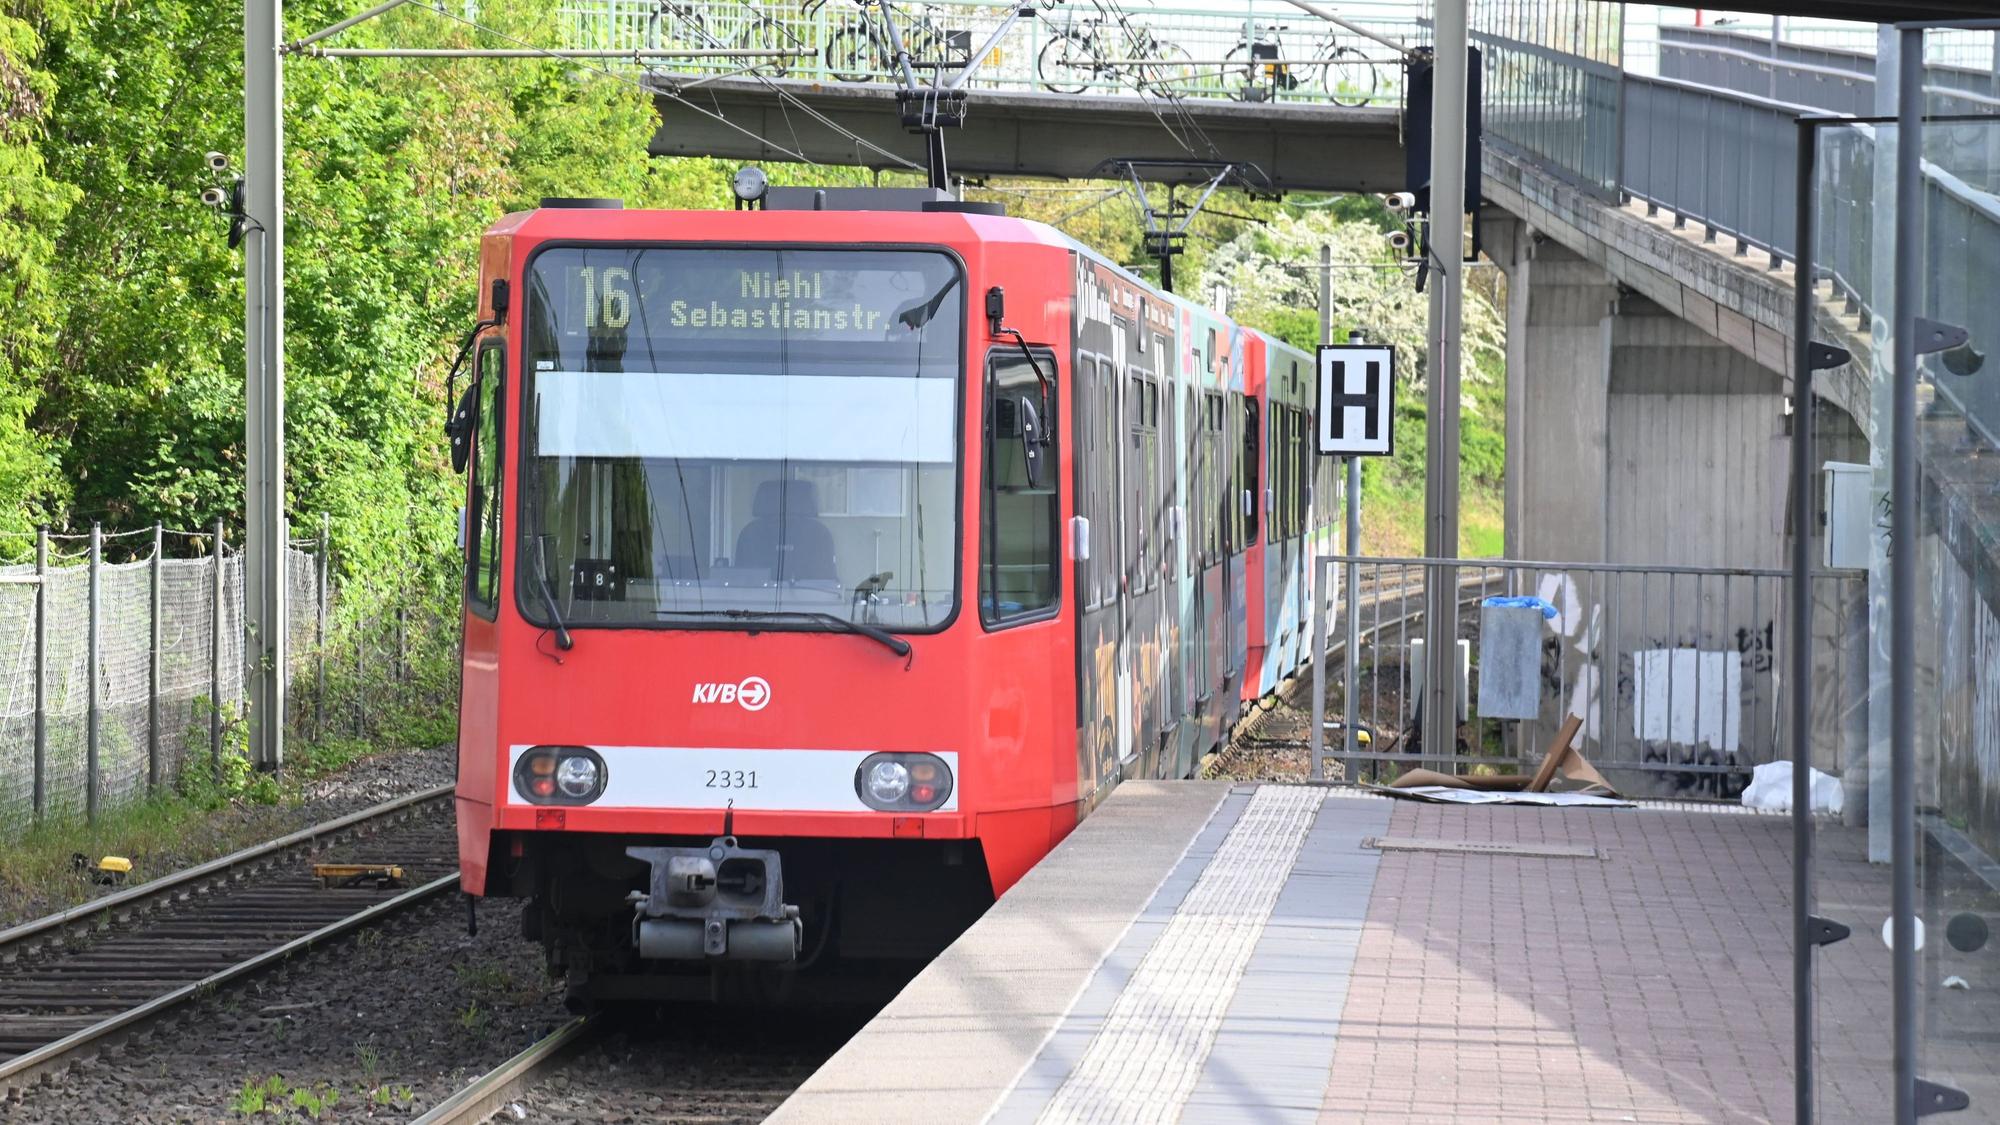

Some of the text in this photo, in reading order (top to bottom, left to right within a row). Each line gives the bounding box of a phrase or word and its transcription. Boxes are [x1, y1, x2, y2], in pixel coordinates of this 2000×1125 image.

[580, 266, 629, 328] 16
[741, 271, 822, 298] Niehl
[671, 300, 890, 330] Sebastianstr.
[1331, 360, 1380, 440] H
[692, 683, 738, 703] KVB
[705, 769, 758, 788] 2331
